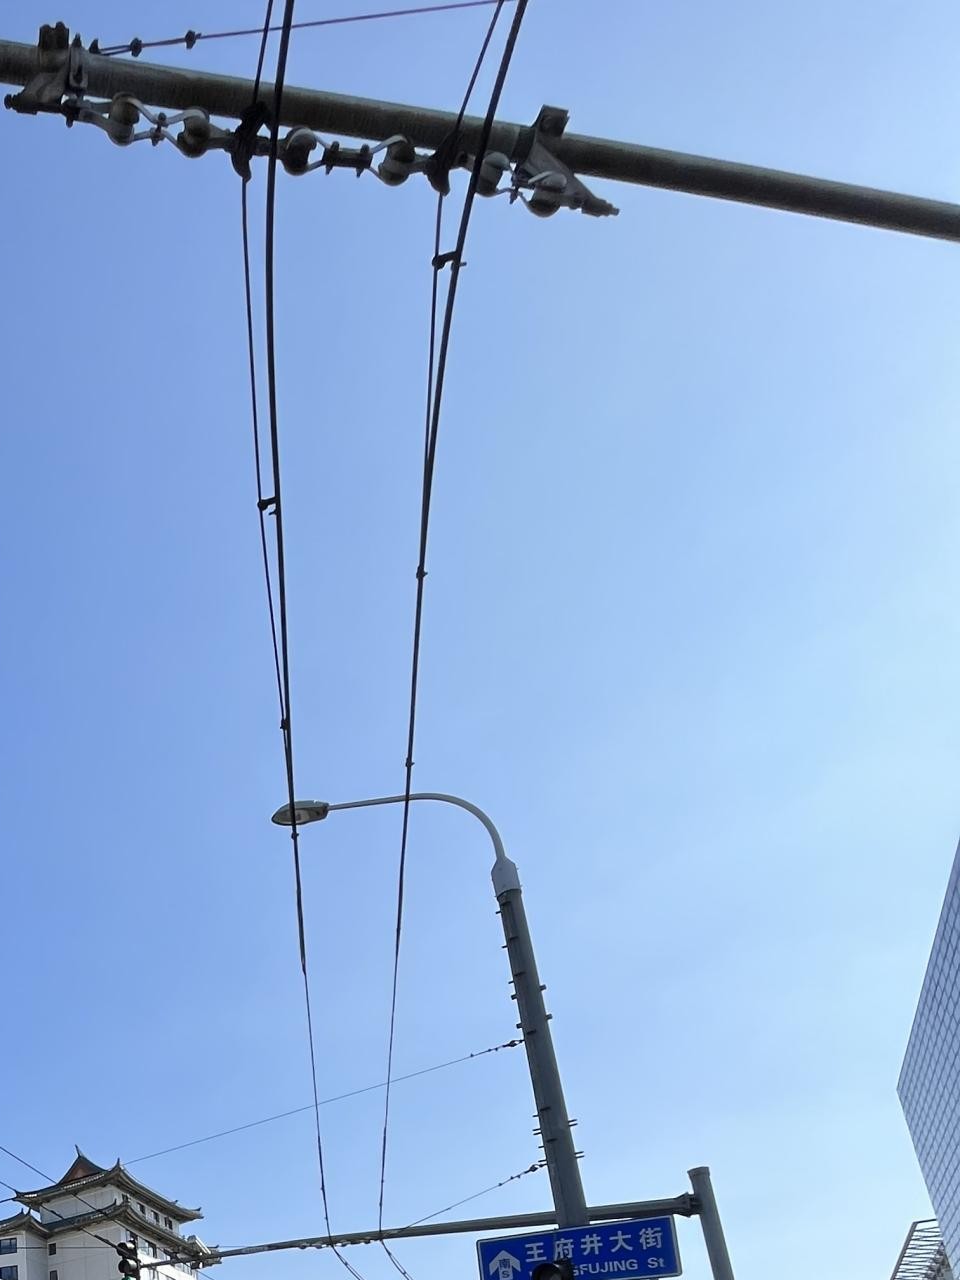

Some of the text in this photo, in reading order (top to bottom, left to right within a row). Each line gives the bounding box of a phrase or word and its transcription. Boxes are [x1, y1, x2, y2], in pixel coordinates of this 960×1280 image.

[525, 1227, 663, 1262] 王府井大街
[499, 1258, 511, 1270] 南
[529, 1256, 665, 1278] GFUJING St
[501, 1270, 511, 1279] S
